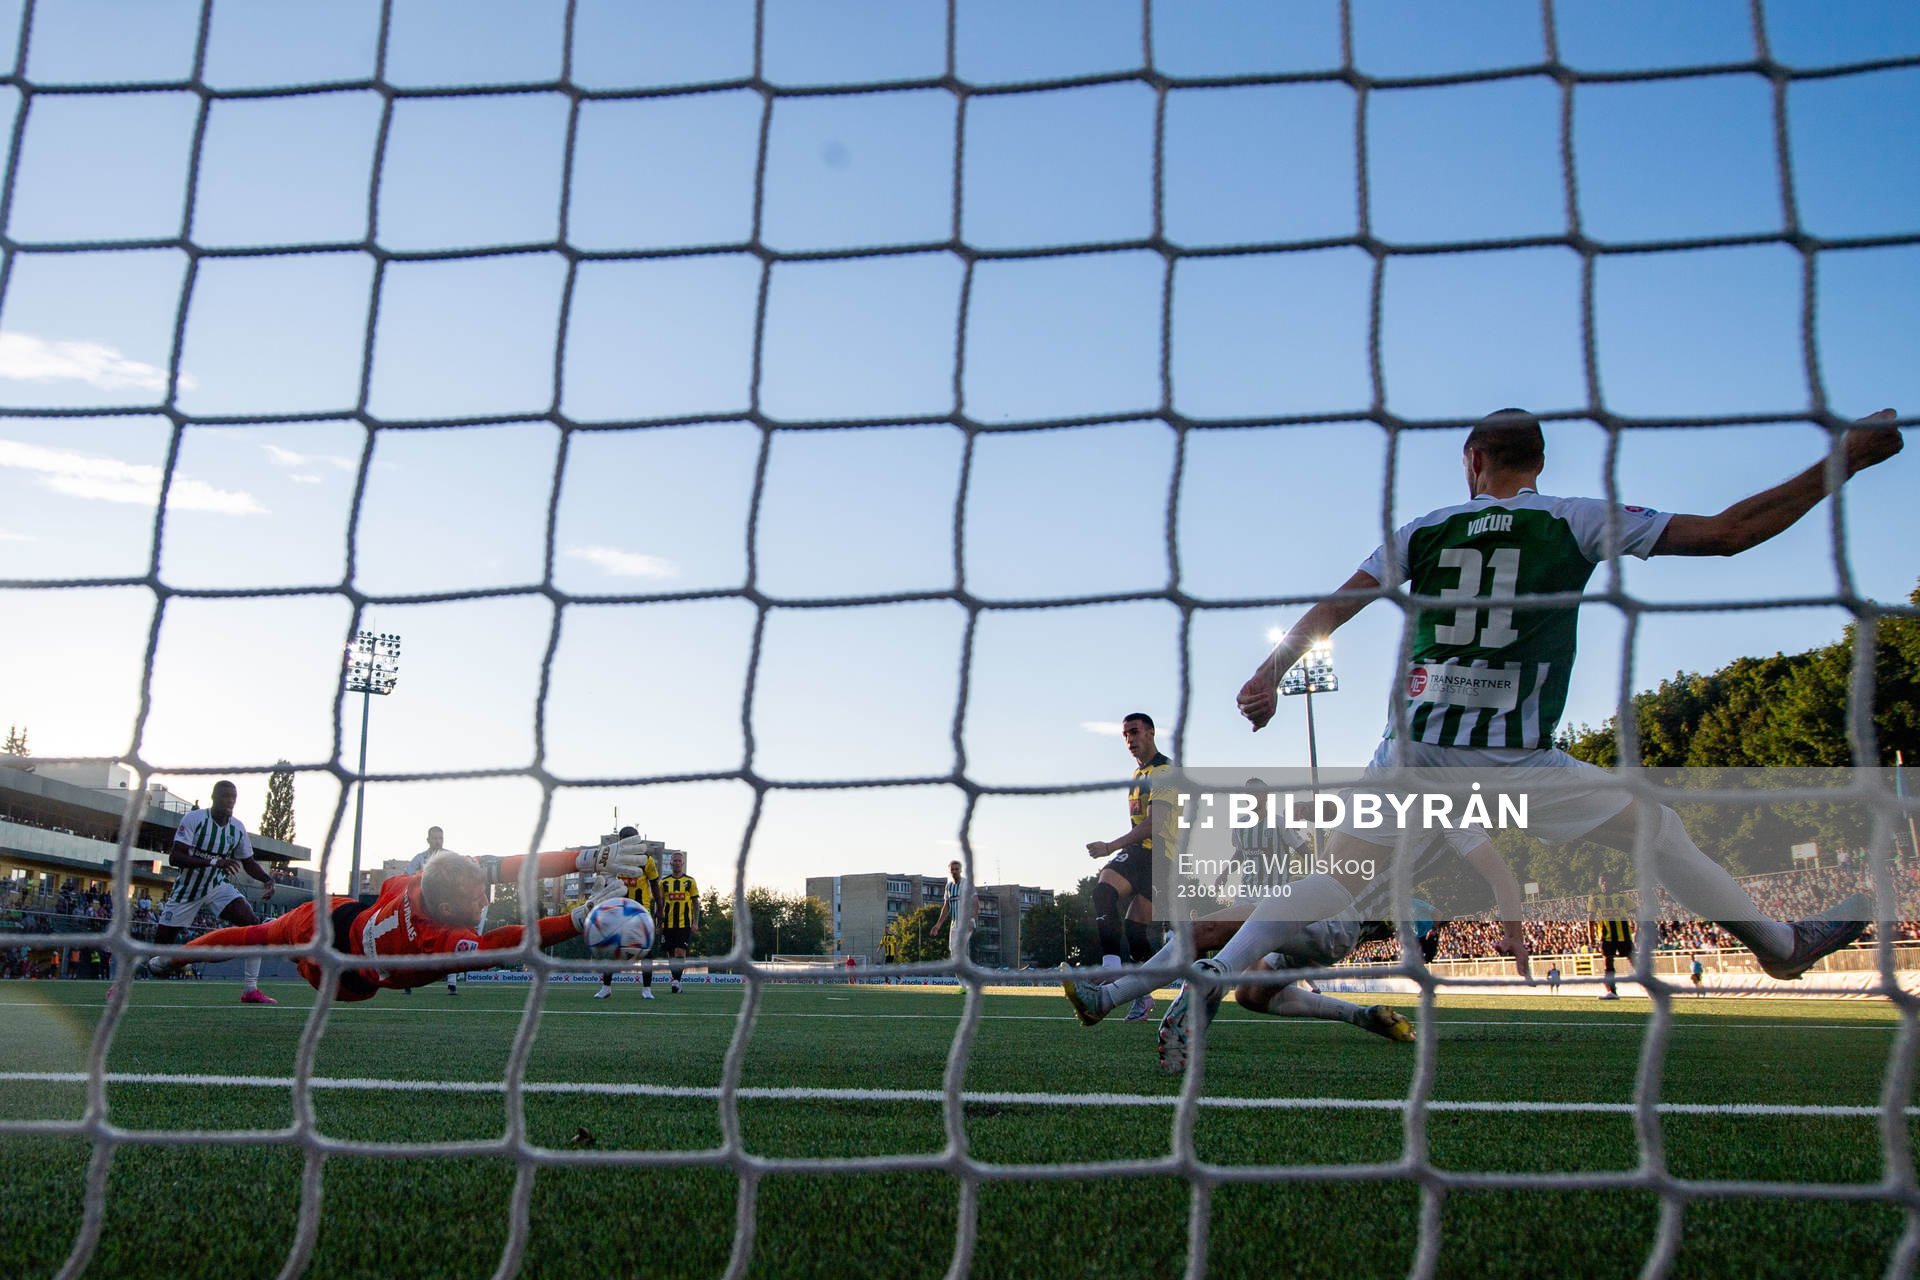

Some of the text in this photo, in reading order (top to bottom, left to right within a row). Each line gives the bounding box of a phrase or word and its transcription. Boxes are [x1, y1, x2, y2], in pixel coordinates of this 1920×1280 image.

[1467, 513, 1513, 537] VUČUR
[1435, 548, 1521, 648] 31
[1430, 674, 1511, 689] TRANSPARTNER
[1429, 683, 1480, 697] LOGISTICS
[467, 974, 493, 982] betsafe
[502, 974, 529, 982] betsafe
[572, 974, 599, 982] betsafe
[612, 975, 634, 983] etsafe
[714, 976, 741, 984] betsafe
